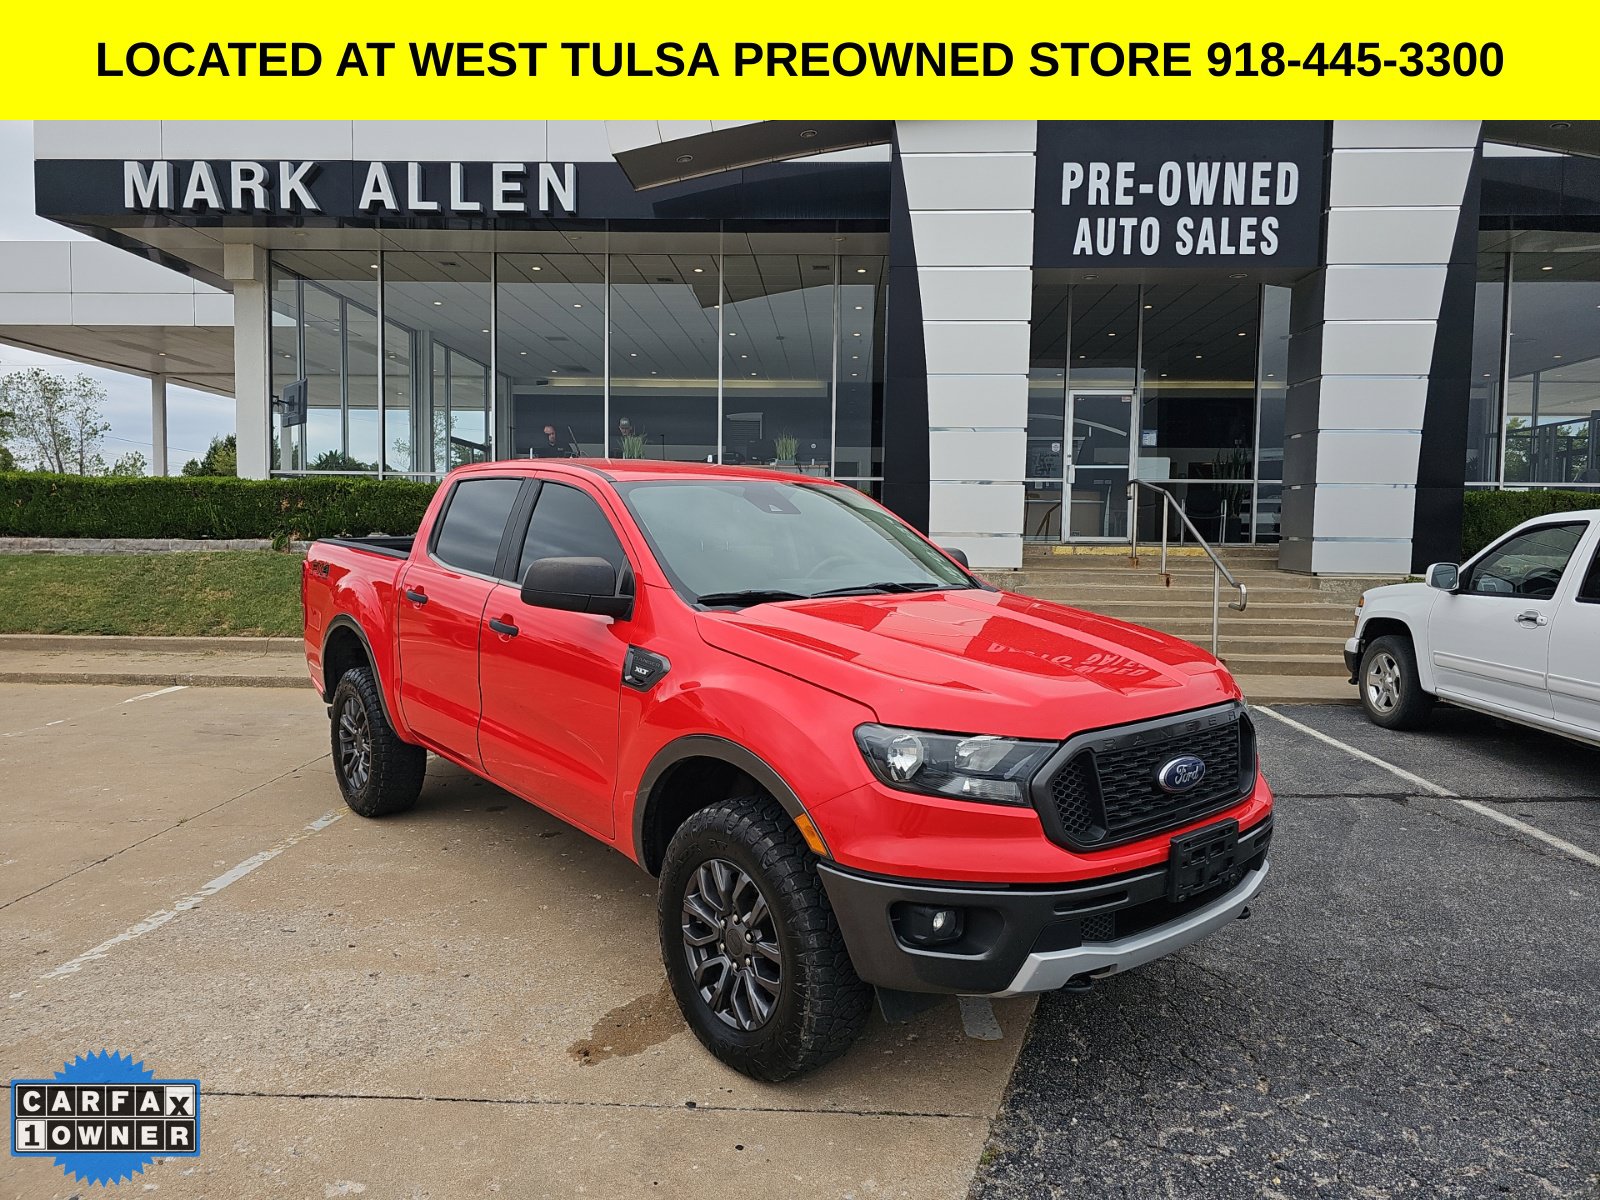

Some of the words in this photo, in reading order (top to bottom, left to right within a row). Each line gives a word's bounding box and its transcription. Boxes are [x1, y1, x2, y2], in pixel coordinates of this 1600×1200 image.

[123, 160, 321, 212] MARK
[358, 161, 577, 214] ALLEN
[1061, 160, 1299, 207] PRE-OWNED
[1072, 215, 1160, 256] AUTO
[1175, 215, 1280, 256] SALES
[634, 666, 649, 675] XLT
[1103, 710, 1236, 750] RANGER
[1173, 763, 1200, 785] Ford
